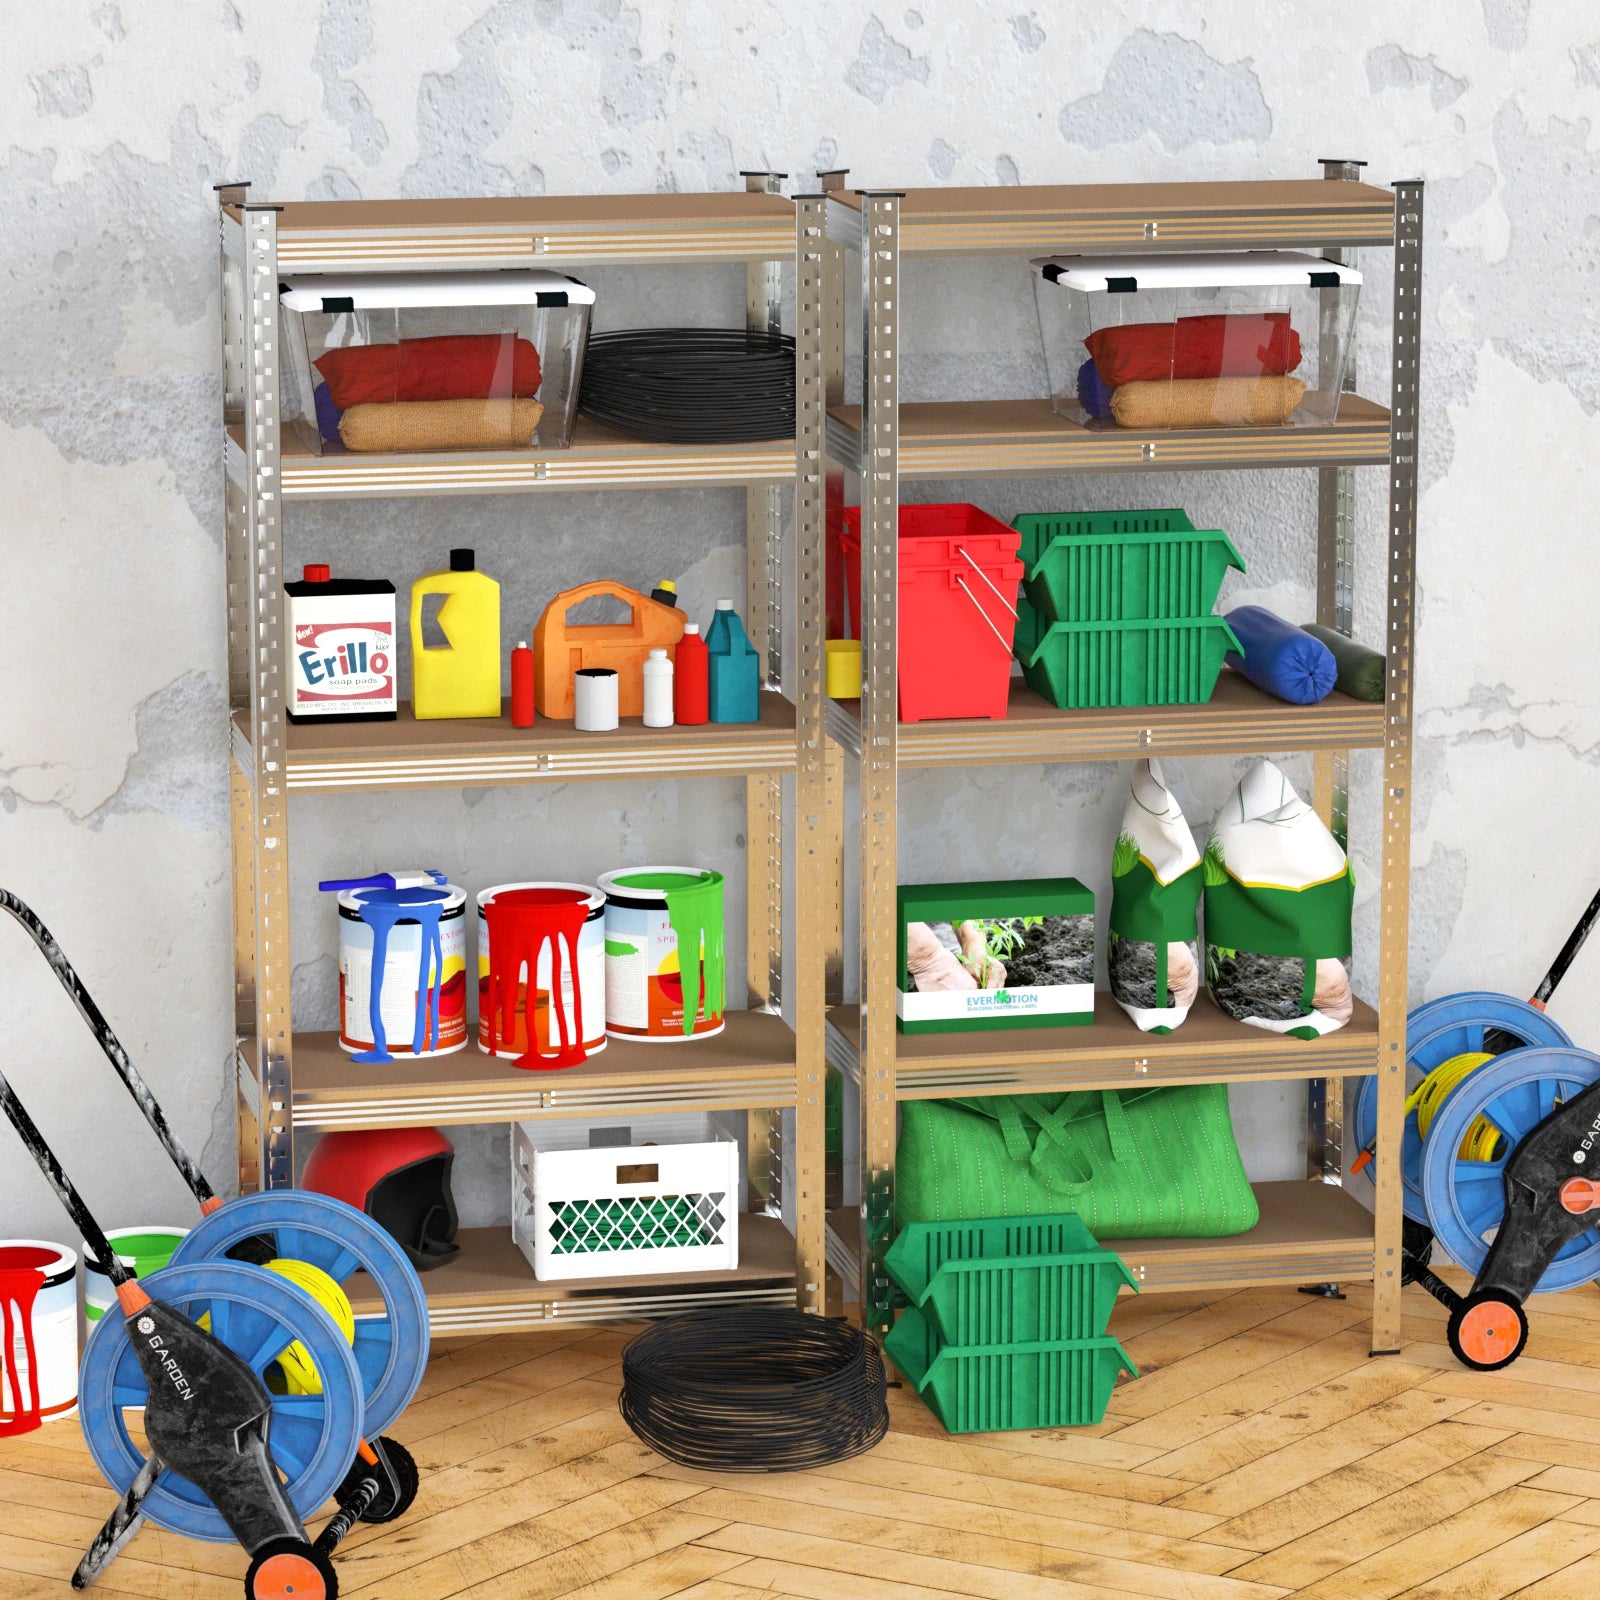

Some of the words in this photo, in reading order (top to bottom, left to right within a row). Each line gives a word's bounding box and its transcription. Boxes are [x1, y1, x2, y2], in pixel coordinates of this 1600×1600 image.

[297, 625, 314, 641] New!
[298, 641, 389, 686] Erillo
[355, 677, 378, 686] pads
[1580, 1112, 1600, 1150] GAR
[148, 1334, 195, 1401] GARDEN
